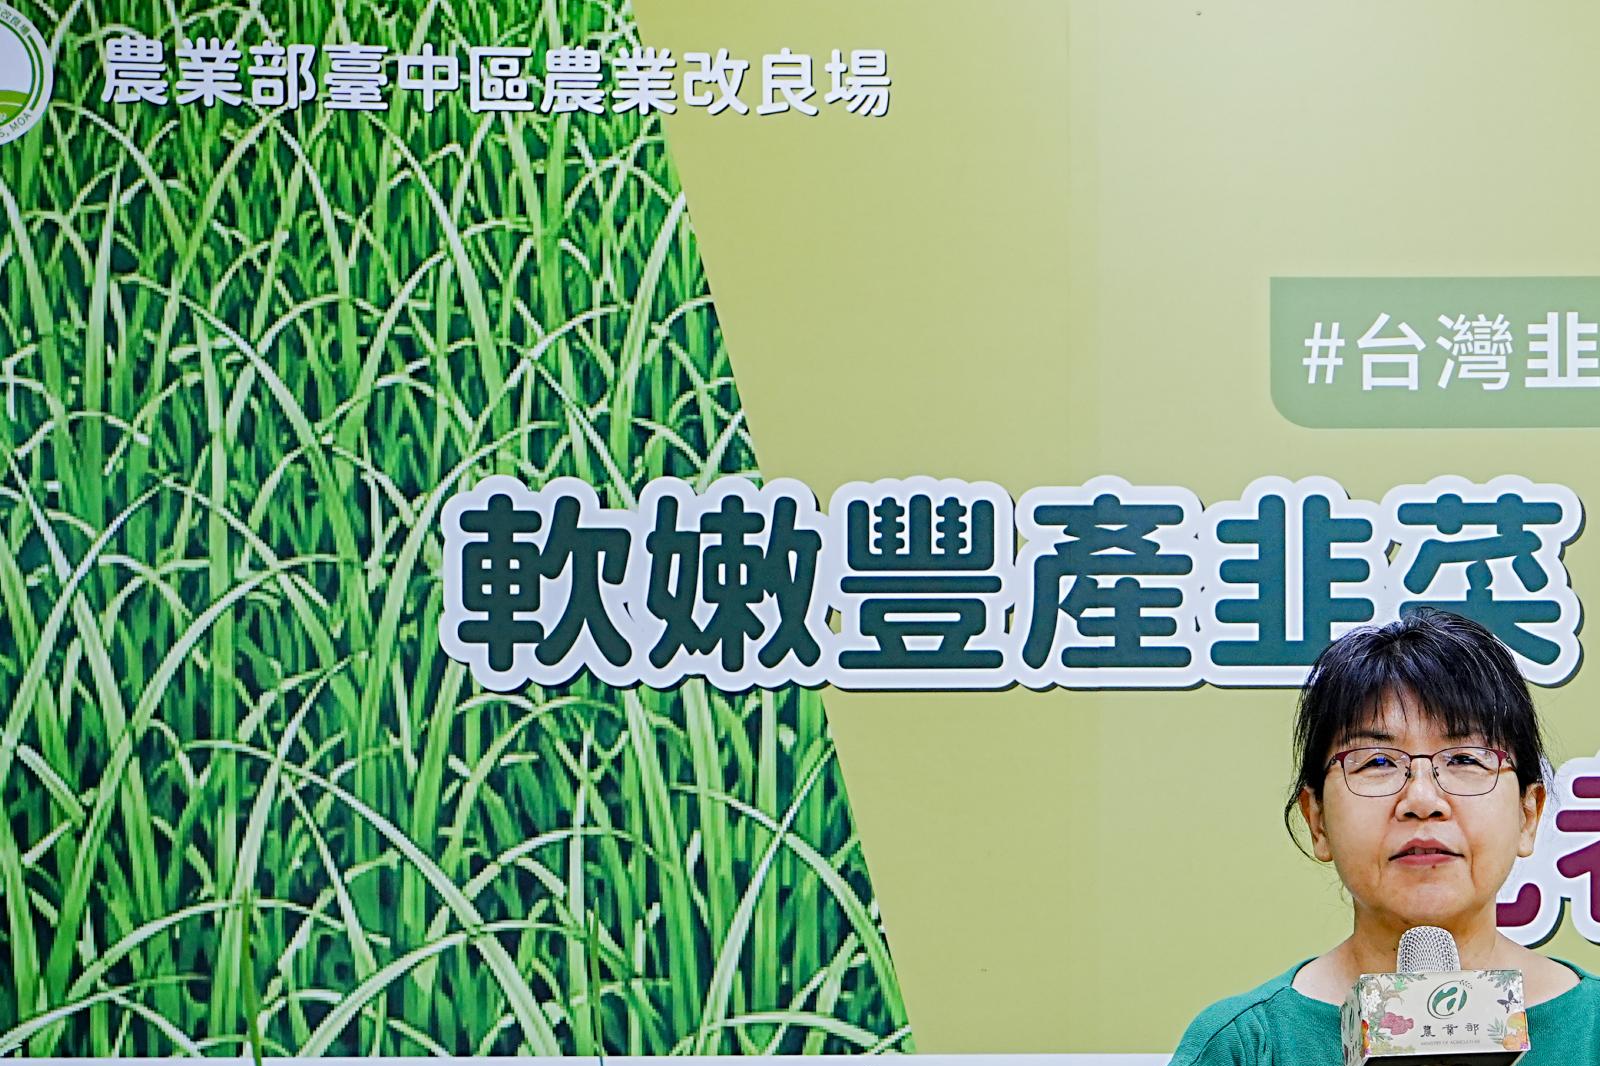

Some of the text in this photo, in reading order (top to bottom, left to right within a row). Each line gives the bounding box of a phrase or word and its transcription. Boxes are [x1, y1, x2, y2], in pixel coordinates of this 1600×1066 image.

[101, 35, 892, 117] 農業部臺中區農業改良場
[457, 490, 1569, 674] 軟嫩豐產韭菜
